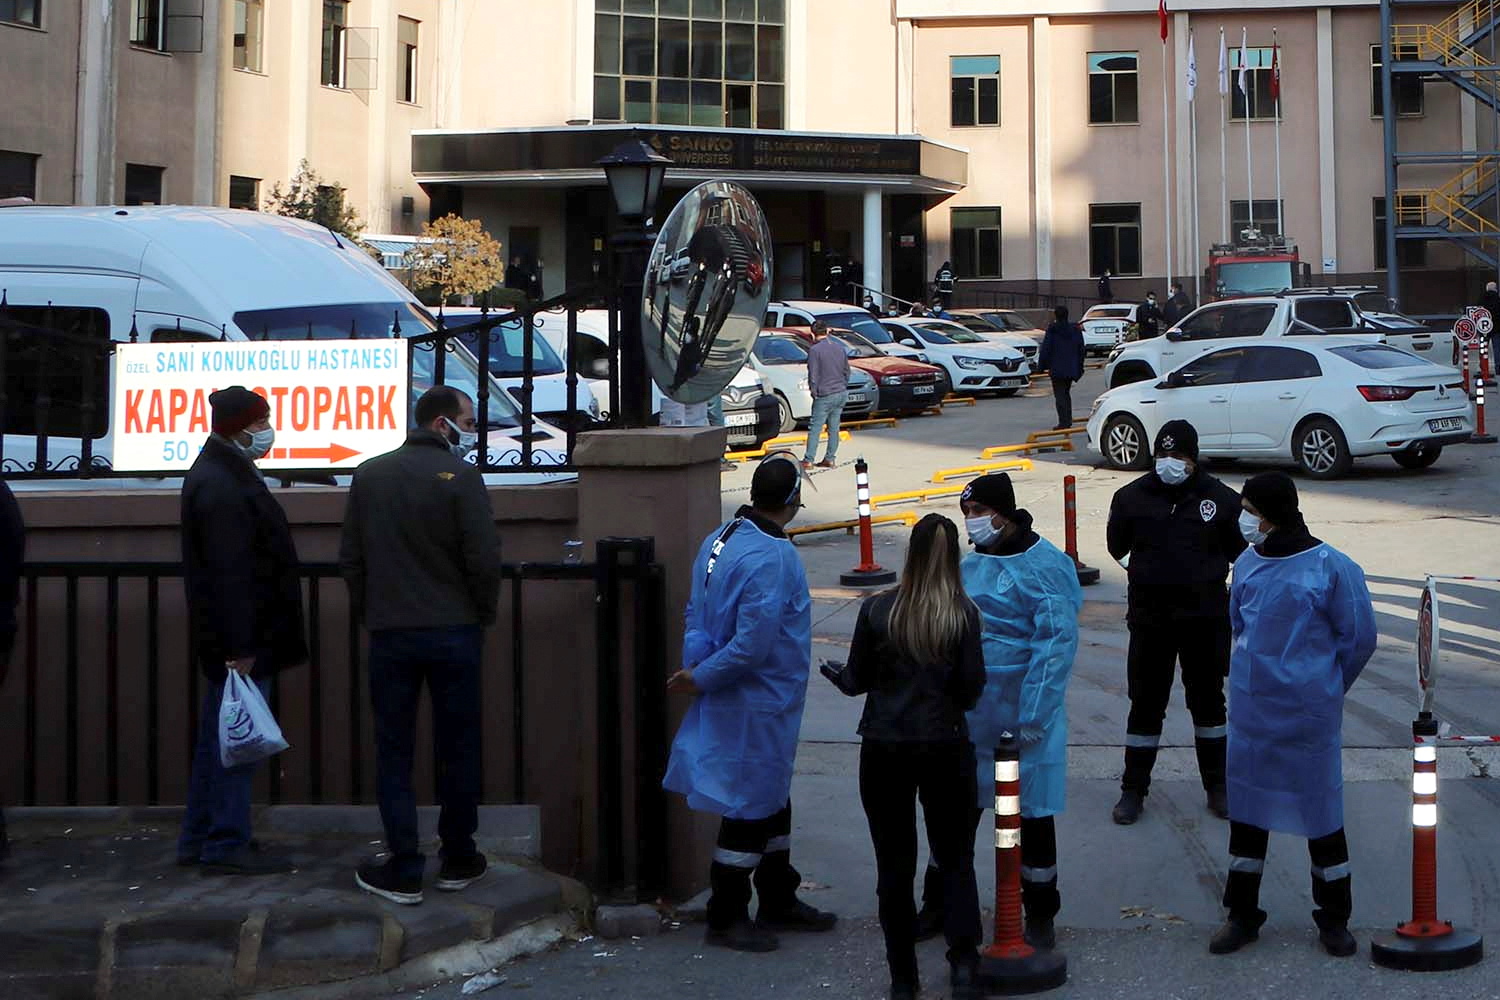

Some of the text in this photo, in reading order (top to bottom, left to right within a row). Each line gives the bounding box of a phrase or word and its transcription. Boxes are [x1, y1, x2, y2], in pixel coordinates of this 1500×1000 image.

[669, 136, 734, 151] SANKO
[126, 360, 150, 374] ÖZEL
[156, 344, 195, 373] SANİ
[307, 341, 398, 370] HASTANESİ
[125, 388, 218, 434] KAPA
[163, 441, 189, 462] 50
